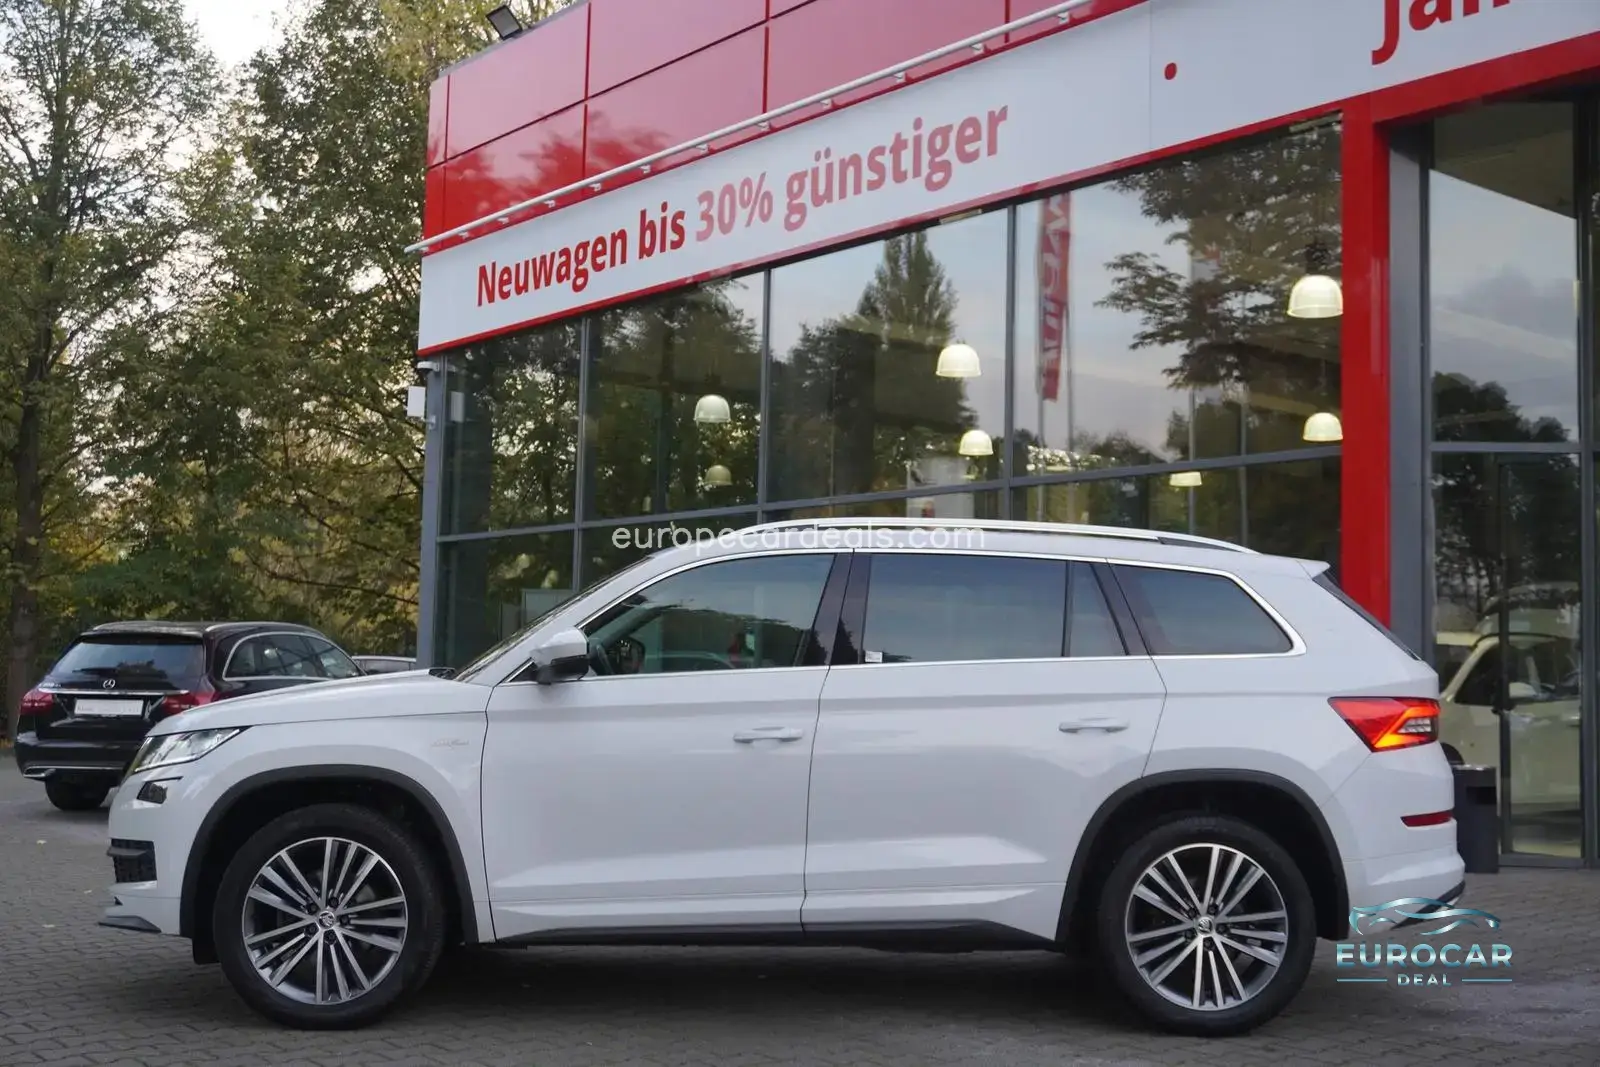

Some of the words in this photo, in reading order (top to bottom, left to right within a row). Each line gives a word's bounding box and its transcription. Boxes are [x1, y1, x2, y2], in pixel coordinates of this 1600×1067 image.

[476, 227, 628, 308] Neuwagen
[637, 200, 686, 261] bis
[695, 171, 774, 243] 30%
[782, 104, 1009, 233] günstiger
